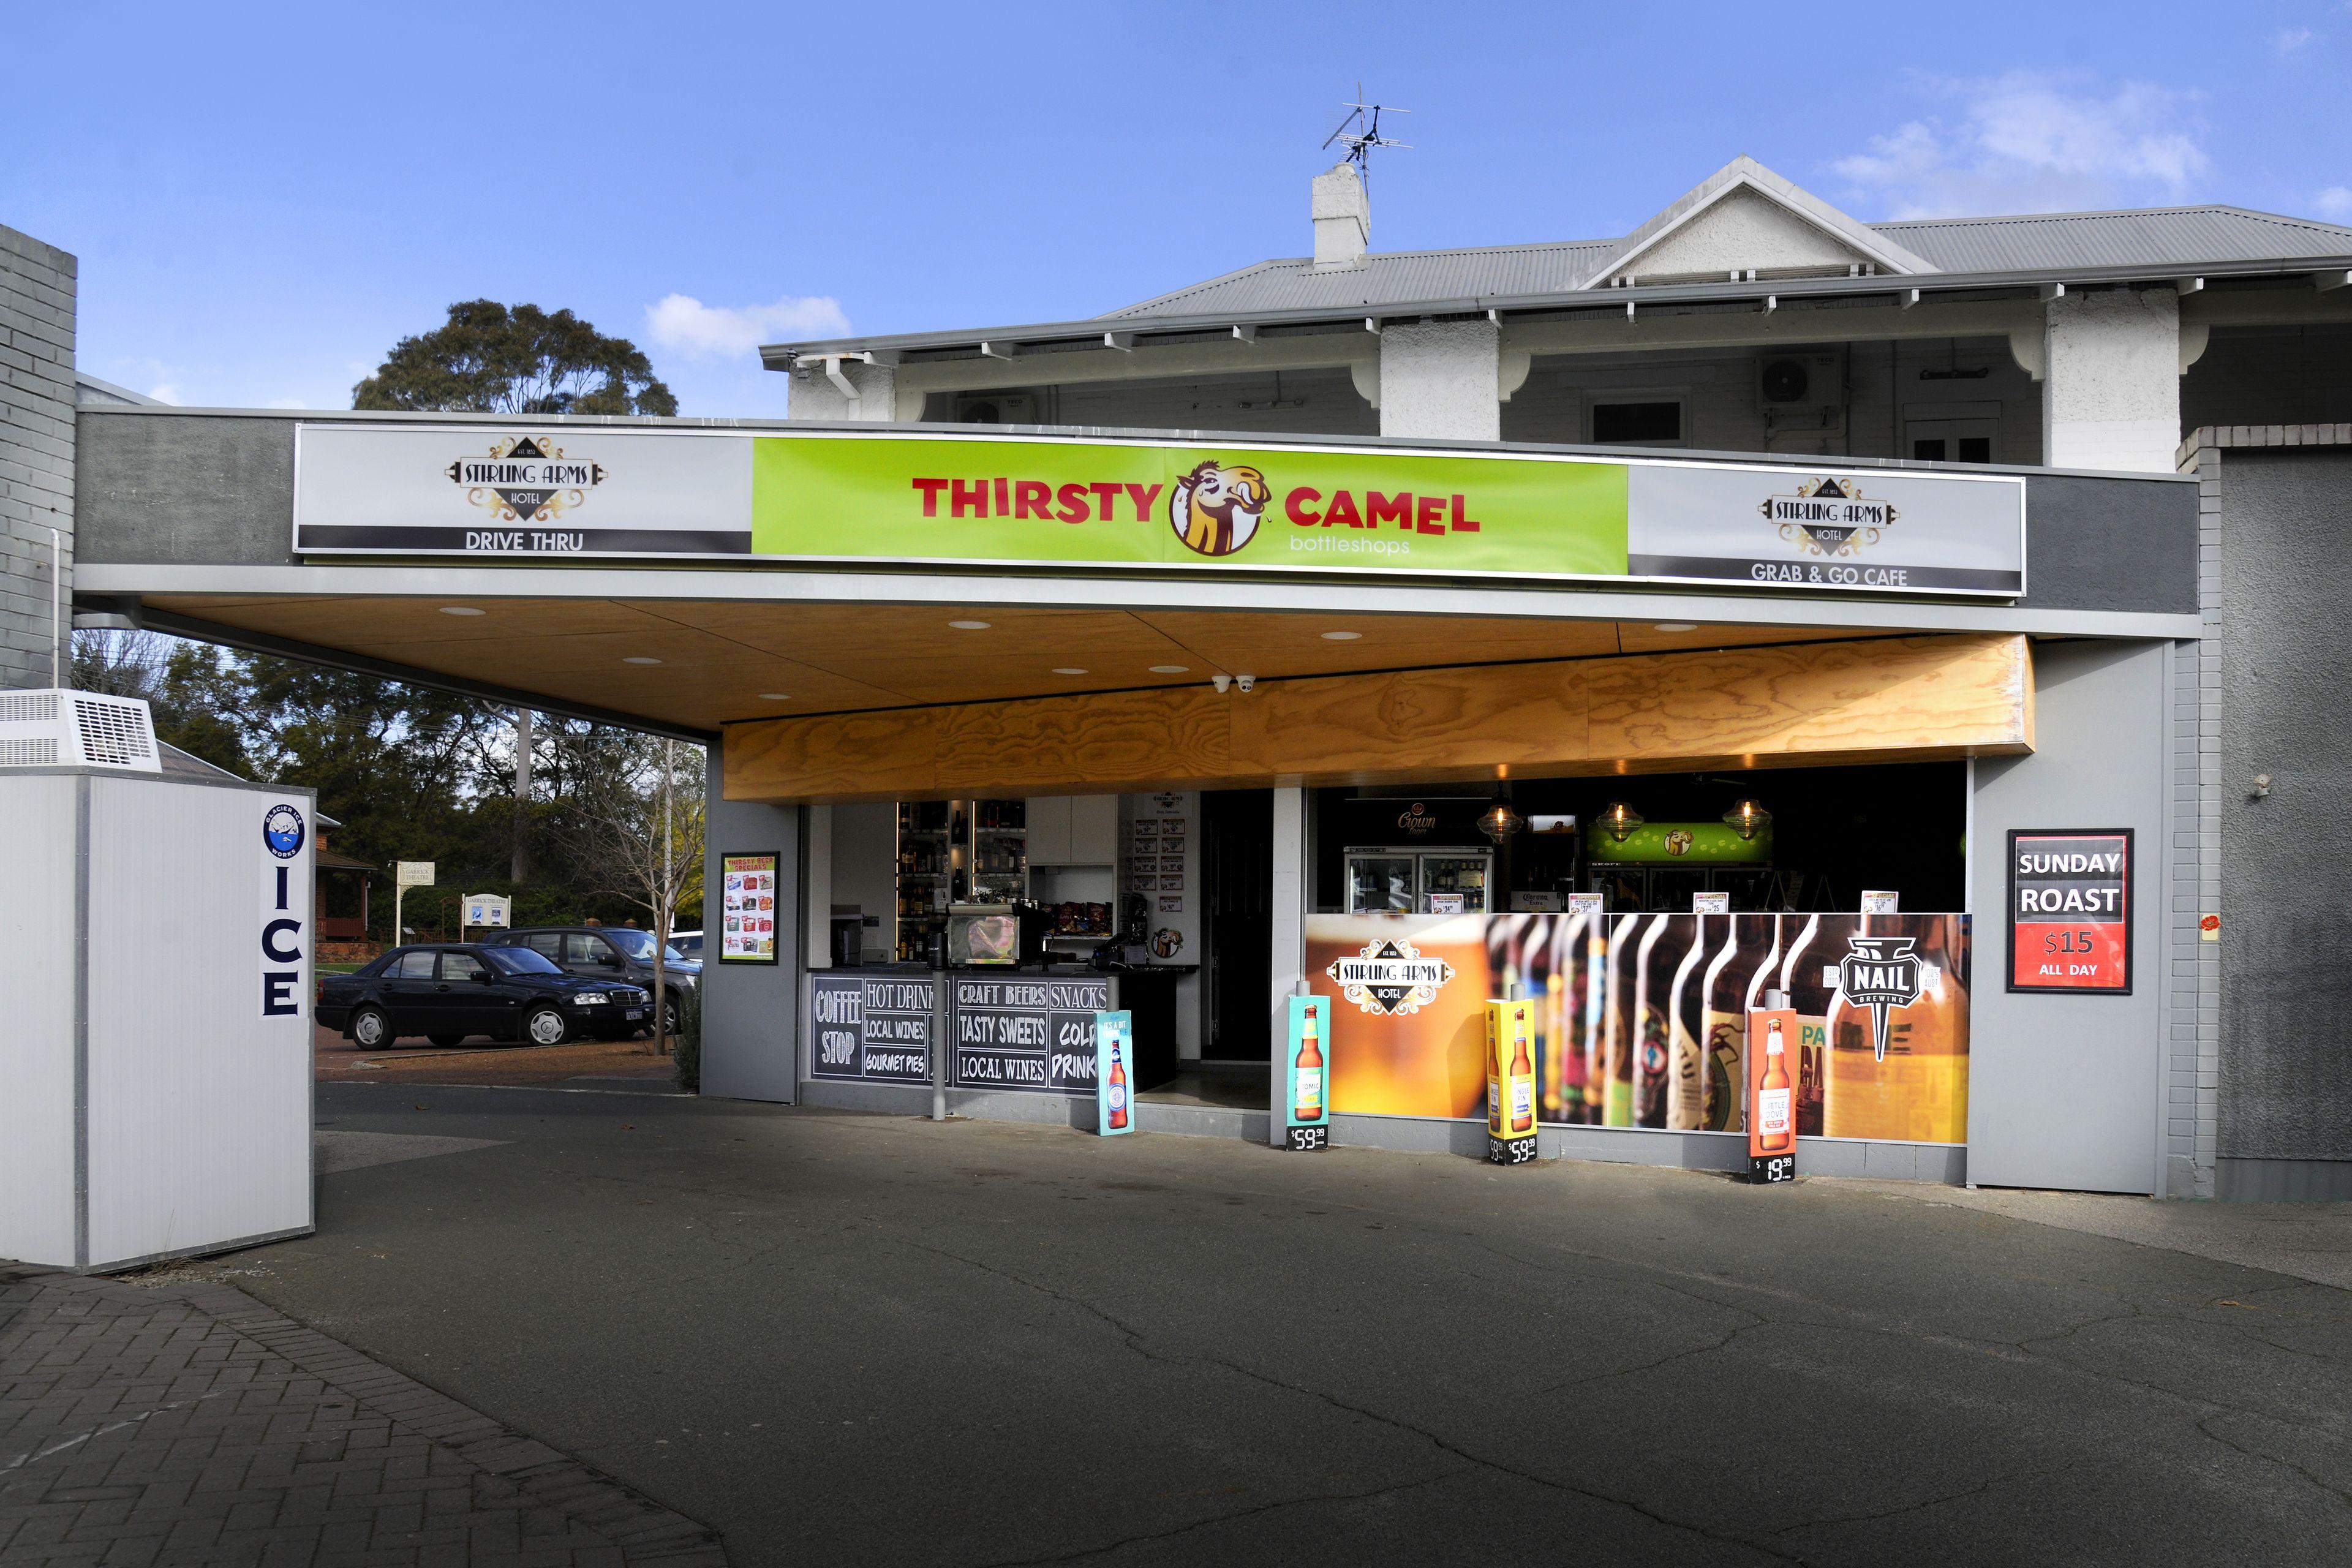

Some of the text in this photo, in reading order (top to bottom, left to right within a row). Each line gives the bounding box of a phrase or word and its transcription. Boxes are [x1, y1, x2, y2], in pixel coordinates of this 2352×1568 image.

[466, 464, 587, 484] STIRLING ARMS
[511, 493, 540, 504] HOTEL
[912, 478, 1480, 535] THIRSTY CAMEL
[1776, 502, 1882, 524] STIRLING ARMS
[466, 532, 583, 551] DRIVE THRU
[1291, 535, 1410, 556] bottleshops
[1817, 530, 1842, 541] HOTEL
[1751, 564, 1907, 586] GRAB & GO CAFE
[266, 806, 302, 825] GLACIER ICE
[1398, 812, 1436, 828] Crown
[272, 848, 296, 858] WORKS
[2019, 853, 2120, 873] SUNDAY
[2021, 888, 2120, 912] ROAST
[262, 866, 303, 1016] ICE
[2045, 931, 2094, 956] $15
[1344, 964, 1437, 981] STIRLING ARMS
[1854, 965, 1910, 992] NAIL
[2039, 964, 2098, 976] ALL DAY
[867, 984, 894, 1008] HOT
[959, 985, 1046, 1006] CRAFT BEERS
[1051, 986, 1107, 1009] SNACKS
[1378, 989, 1401, 999] HOTEL
[1860, 995, 1904, 1004] BREWING
[815, 990, 862, 1025] COFFEE
[865, 1020, 924, 1040] LOCAL WINES
[960, 1016, 1046, 1045] TASTY SWEETS
[821, 1031, 855, 1065] STOP
[865, 1053, 924, 1073] GOURMET PIES
[962, 1057, 1044, 1082] LOCAL WINES
[1052, 1054, 1096, 1079] DRINK
